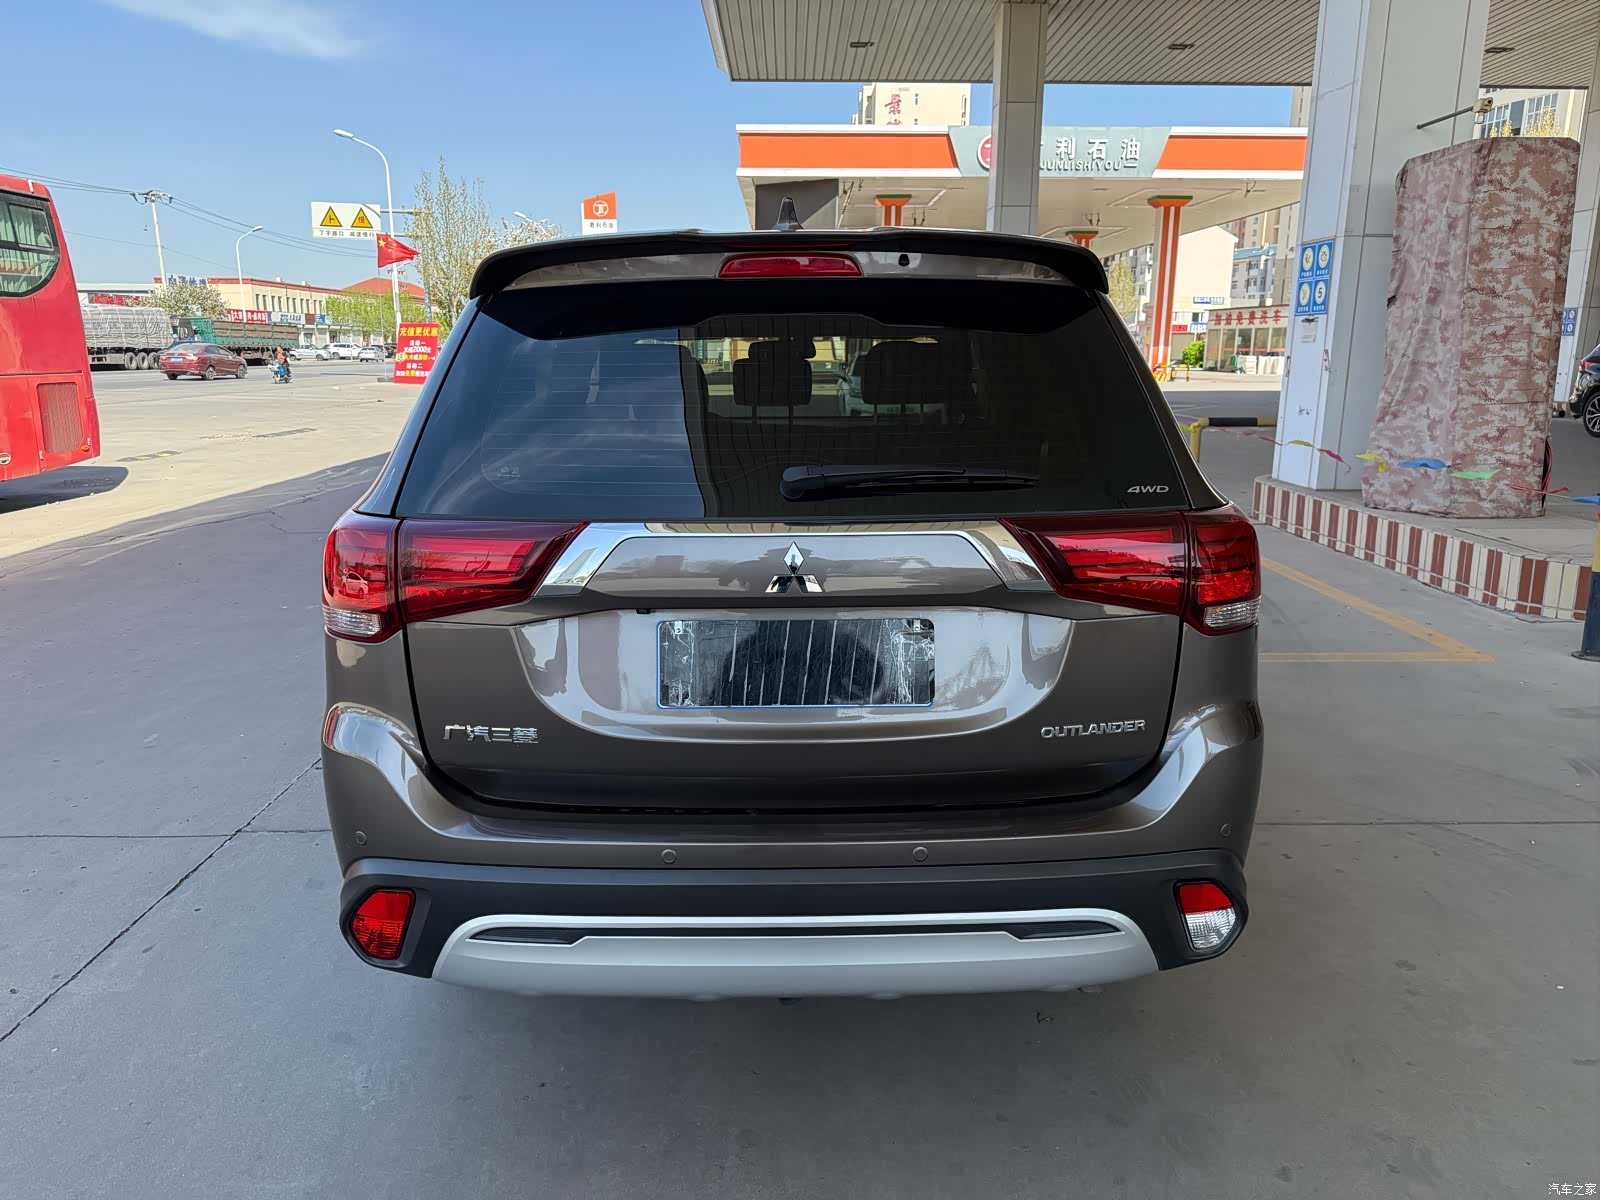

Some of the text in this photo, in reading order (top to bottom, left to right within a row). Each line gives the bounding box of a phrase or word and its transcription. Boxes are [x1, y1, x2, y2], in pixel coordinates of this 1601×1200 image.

[1041, 136, 1141, 161] 利石油
[1214, 309, 1282, 326] 加油免费洗车
[399, 327, 439, 337] 充值更优惠
[1127, 485, 1169, 494] 4WD
[443, 724, 539, 744] 广汽三菱
[1040, 720, 1146, 738] OUTLANDER
